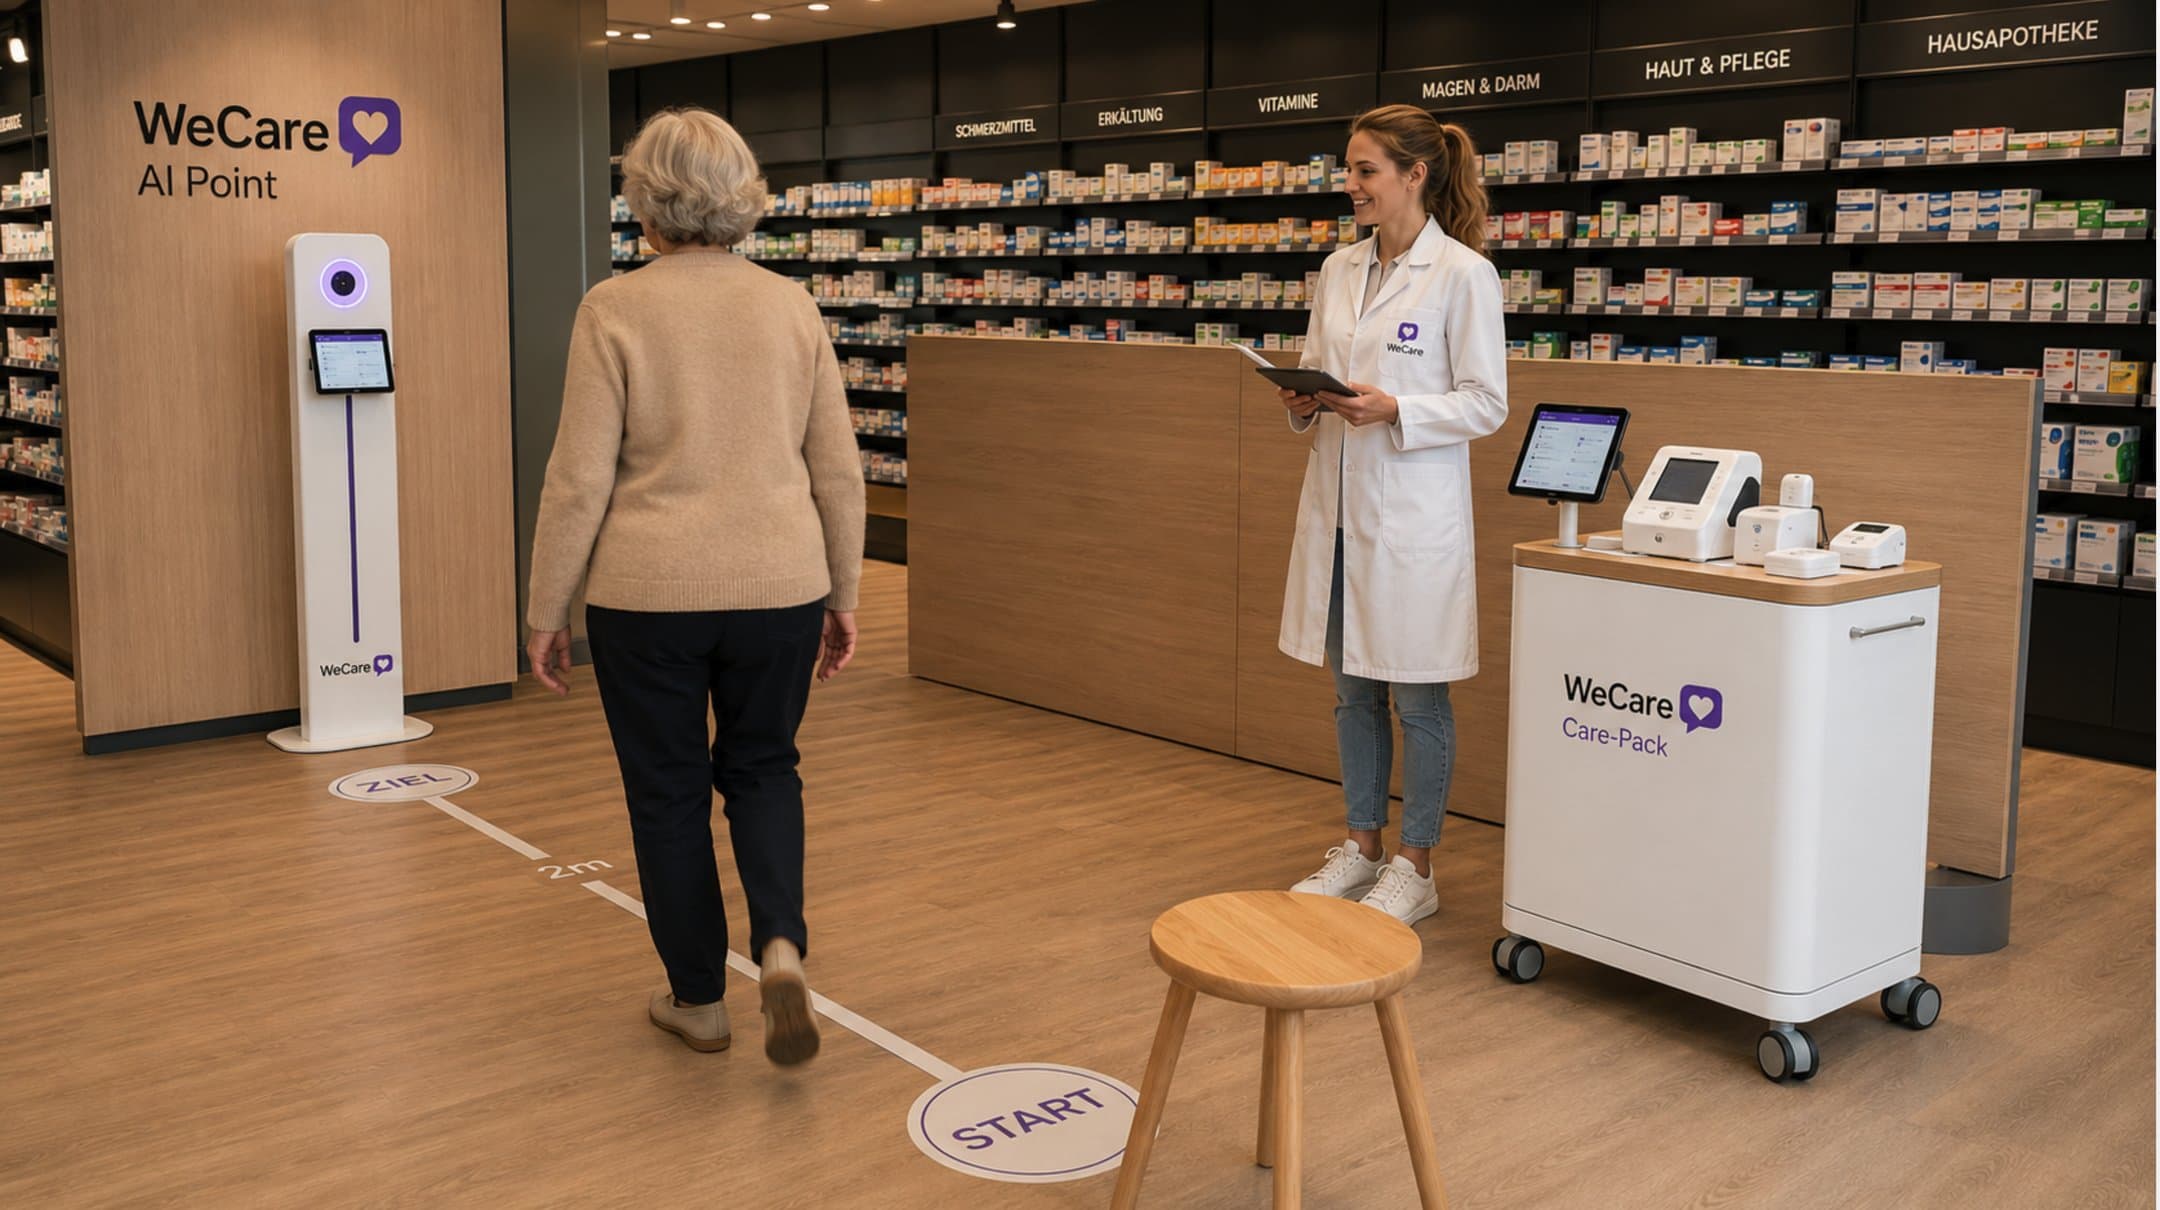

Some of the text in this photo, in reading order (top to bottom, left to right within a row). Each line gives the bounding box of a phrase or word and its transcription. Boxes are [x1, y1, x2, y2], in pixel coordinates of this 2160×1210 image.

[1927, 19, 2099, 54] HAUSAPOTHEKE
[1645, 48, 1791, 80] HAUT & PFLEGE
[1422, 72, 1540, 99] MAGEN & DARM
[1258, 92, 1319, 113] VITAMINE
[133, 100, 329, 152] WeCare
[955, 118, 1037, 139] SCHMERZMITTEL
[1098, 106, 1163, 127] ERKÄLTUNG
[138, 163, 278, 199] AI Point
[1386, 343, 1424, 357] WeCare
[319, 662, 371, 677] WeCare
[1564, 673, 1674, 720] WeCare
[1562, 716, 1668, 758] Care-Pack
[356, 773, 453, 793] ZIEL
[537, 859, 614, 880] 2m
[952, 1087, 1105, 1151] START
